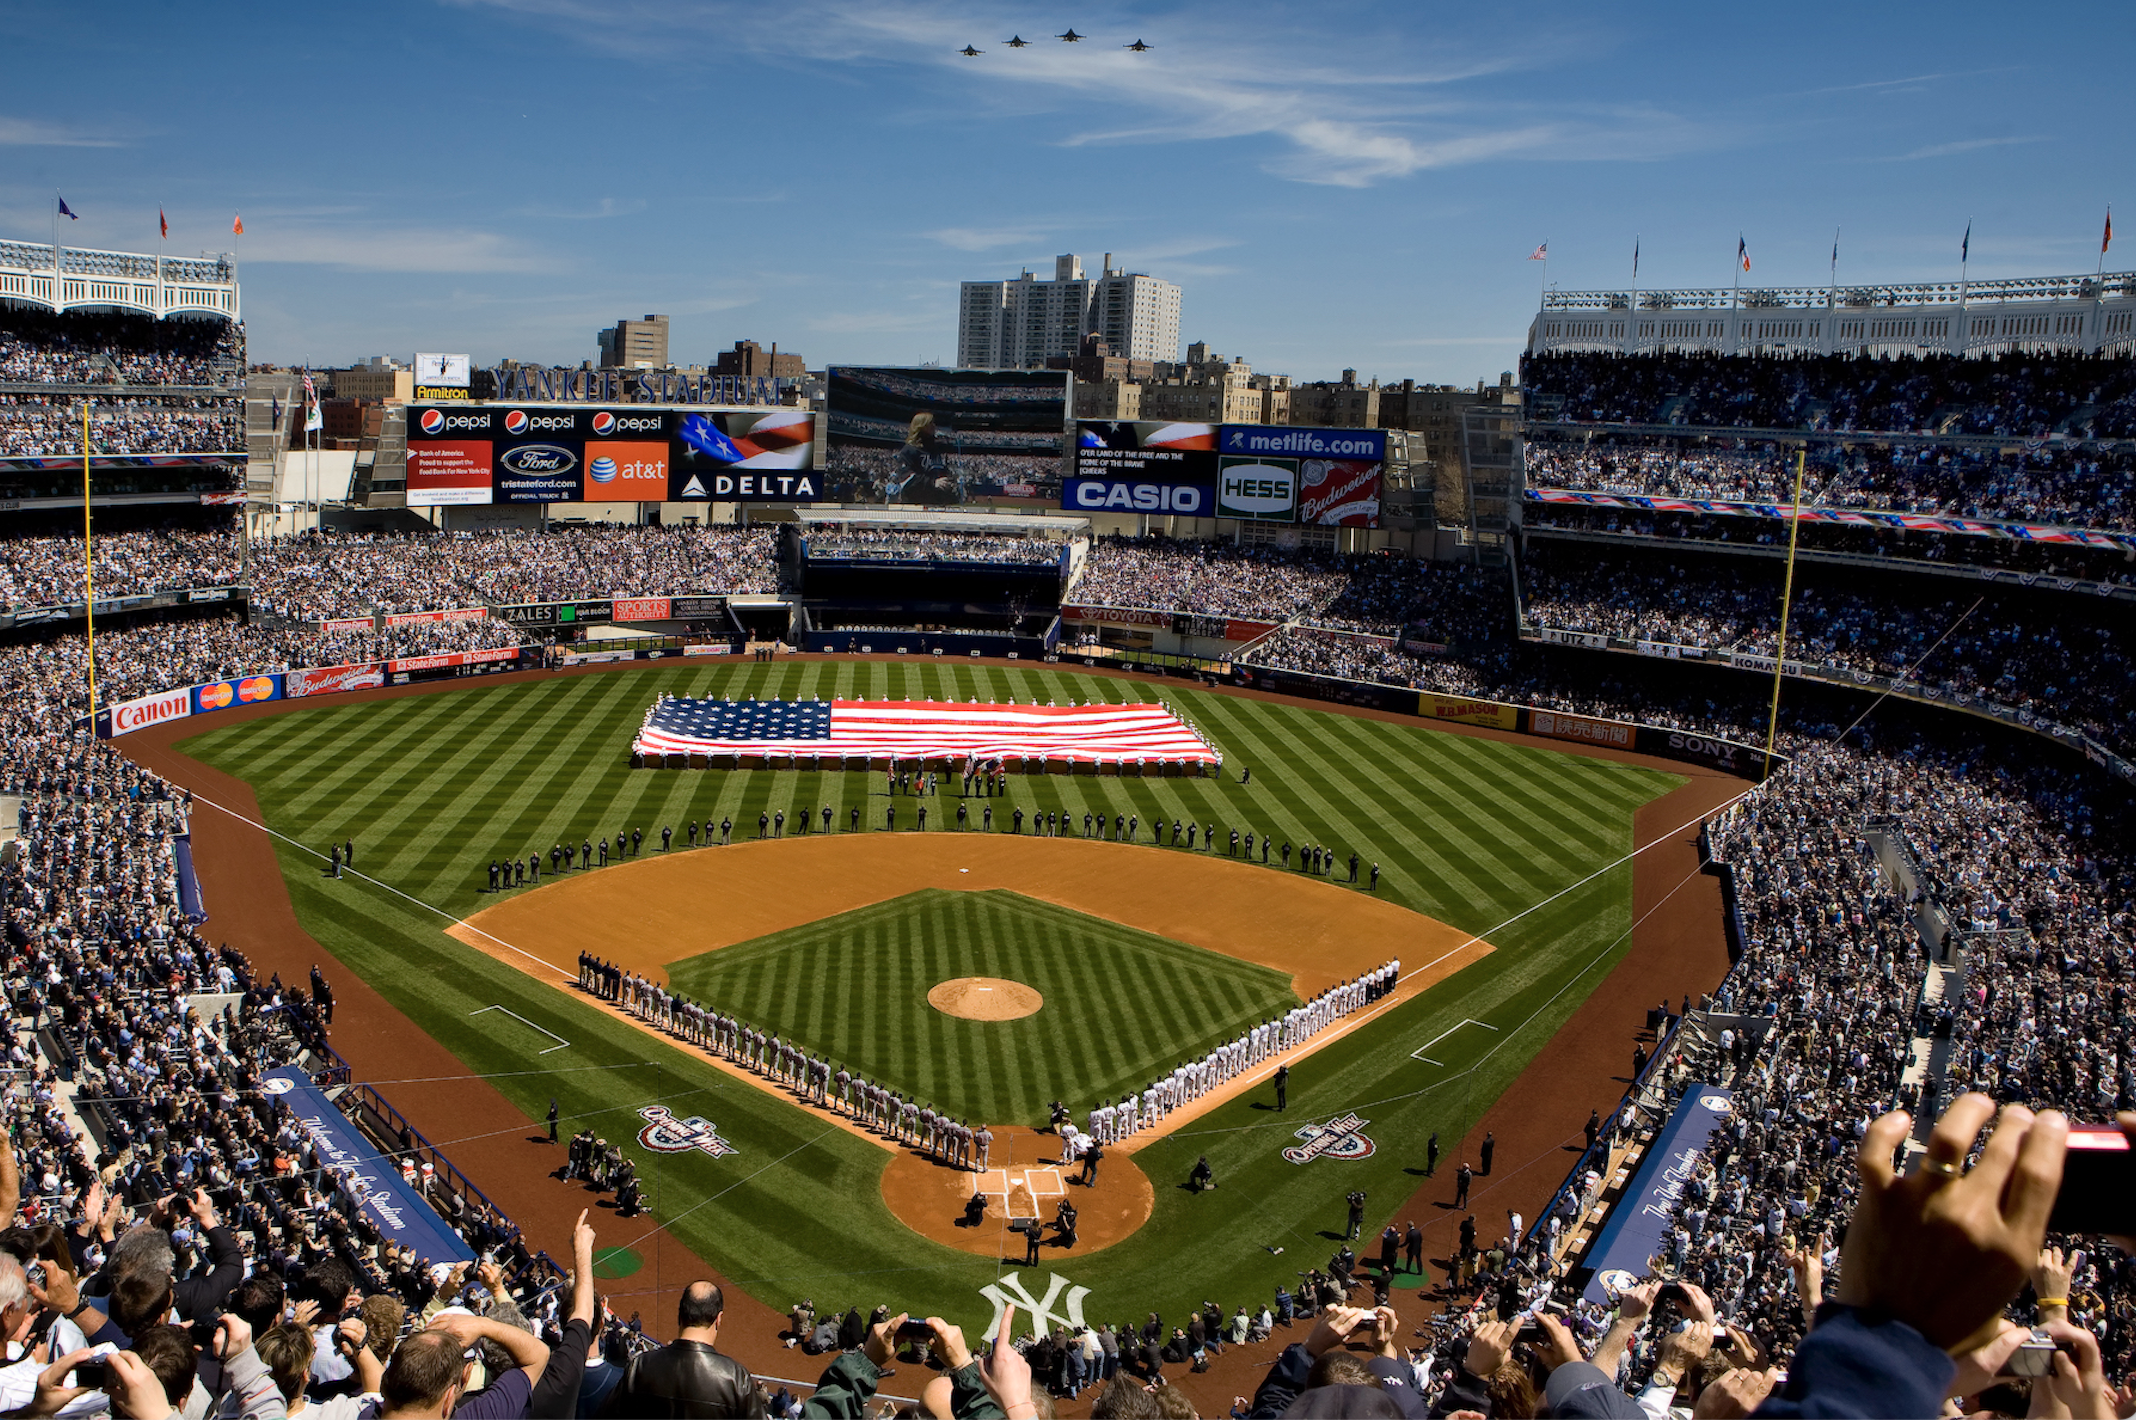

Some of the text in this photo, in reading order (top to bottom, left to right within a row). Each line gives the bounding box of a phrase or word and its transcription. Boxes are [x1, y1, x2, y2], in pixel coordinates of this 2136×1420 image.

[417, 386, 468, 399] Armitron
[491, 369, 781, 406] YANKEE STADIUM
[446, 413, 491, 431] pepsi
[530, 414, 575, 431] pepsi
[616, 415, 662, 432] pepsi
[1250, 432, 1375, 455] metlife.com
[518, 451, 560, 469] Ford
[622, 460, 665, 479] at&t
[1110, 460, 1123, 468] THE
[1124, 461, 1145, 469] BRAVE
[501, 479, 577, 488] tristateford.com
[715, 475, 815, 496] DELTA
[1225, 478, 1290, 499] HESS
[1299, 462, 1382, 523] Budweiser
[1077, 481, 1201, 512] CASIO
[508, 606, 552, 621] ZALES
[617, 600, 668, 613] SPORTS
[617, 610, 667, 620] AUTHORITY
[1100, 609, 1153, 624] TOYOTA
[1560, 632, 1585, 645] UTZ
[297, 664, 371, 698] Budweiser
[116, 695, 187, 730] Canon
[1555, 717, 1628, 745] 読売新聞
[1668, 733, 1737, 759] SONY
[642, 1106, 696, 1138] OPENING
[1322, 1115, 1364, 1136] WEEK
[689, 1131, 730, 1156] WEEK
[1285, 1132, 1341, 1161] OPENING
[1641, 1146, 1700, 1220] New York Yankees
[364, 1190, 406, 1231] Stadium
